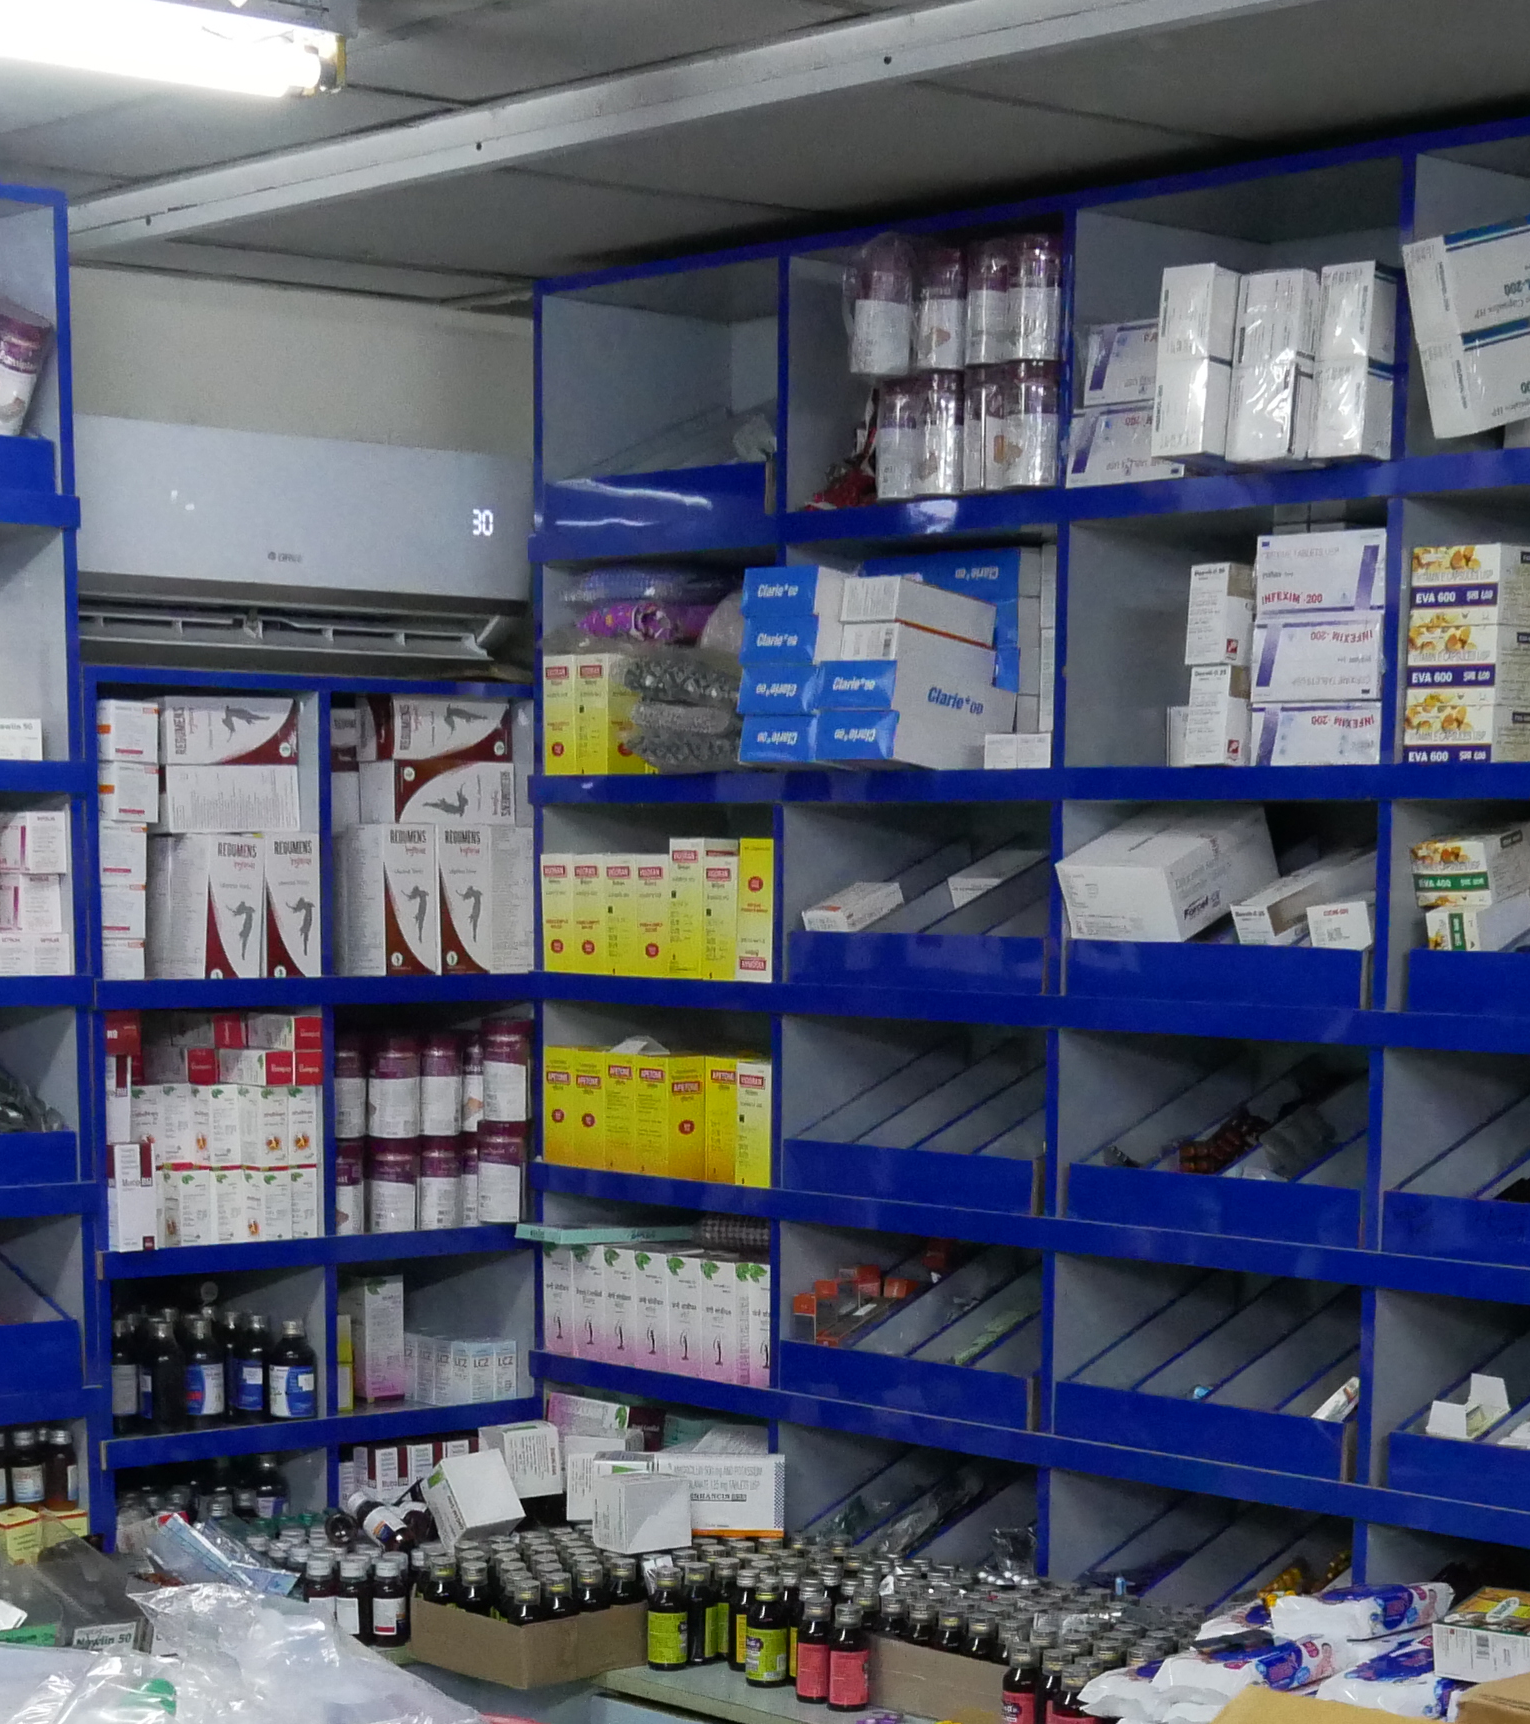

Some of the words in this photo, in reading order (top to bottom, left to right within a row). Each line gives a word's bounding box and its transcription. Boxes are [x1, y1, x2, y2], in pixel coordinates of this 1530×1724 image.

[472, 509, 494, 536] 30
[1416, 592, 1435, 603] EVA
[1437, 592, 1456, 603] 600
[1412, 671, 1431, 683] EVA
[1434, 671, 1452, 683] 600
[1408, 750, 1427, 762] EVA
[1430, 750, 1449, 762] 600
